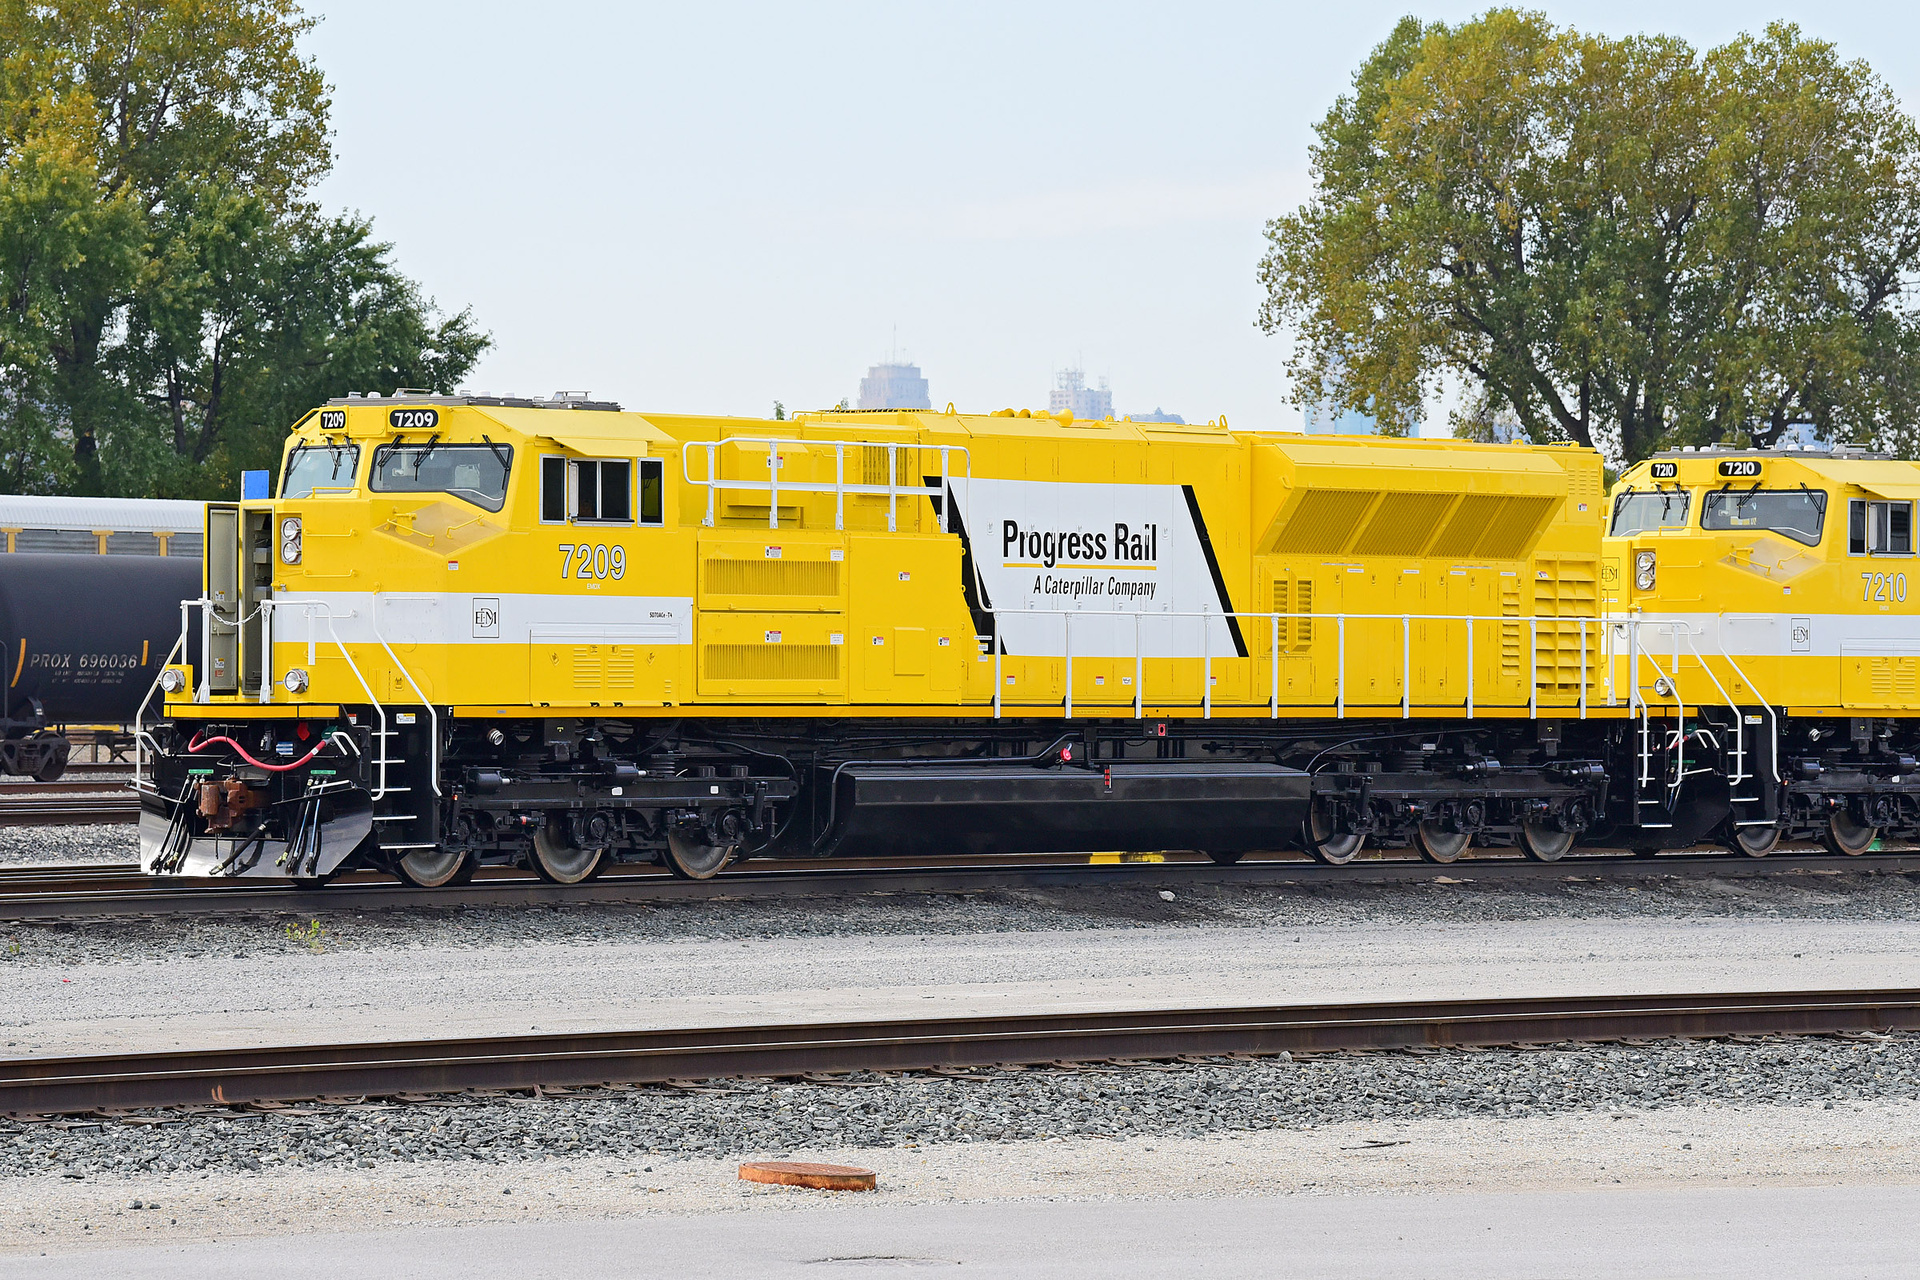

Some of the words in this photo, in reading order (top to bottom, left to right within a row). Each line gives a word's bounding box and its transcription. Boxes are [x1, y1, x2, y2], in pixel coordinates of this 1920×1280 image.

[322, 412, 344, 428] 7209
[394, 412, 434, 428] 7209
[1655, 464, 1674, 477] 7210
[1725, 462, 1755, 475] 7210
[1003, 520, 1107, 568] Progress
[1114, 523, 1157, 561] Rail
[559, 544, 627, 580] 7209
[1033, 576, 1042, 594] A
[1044, 575, 1105, 600] Caterpillar
[1107, 577, 1157, 601] Company
[1861, 572, 1907, 602] 7210
[30, 653, 71, 668] PROX
[79, 653, 138, 669] 696036
[448, 706, 453, 717] F
[1783, 707, 1788, 716] F
